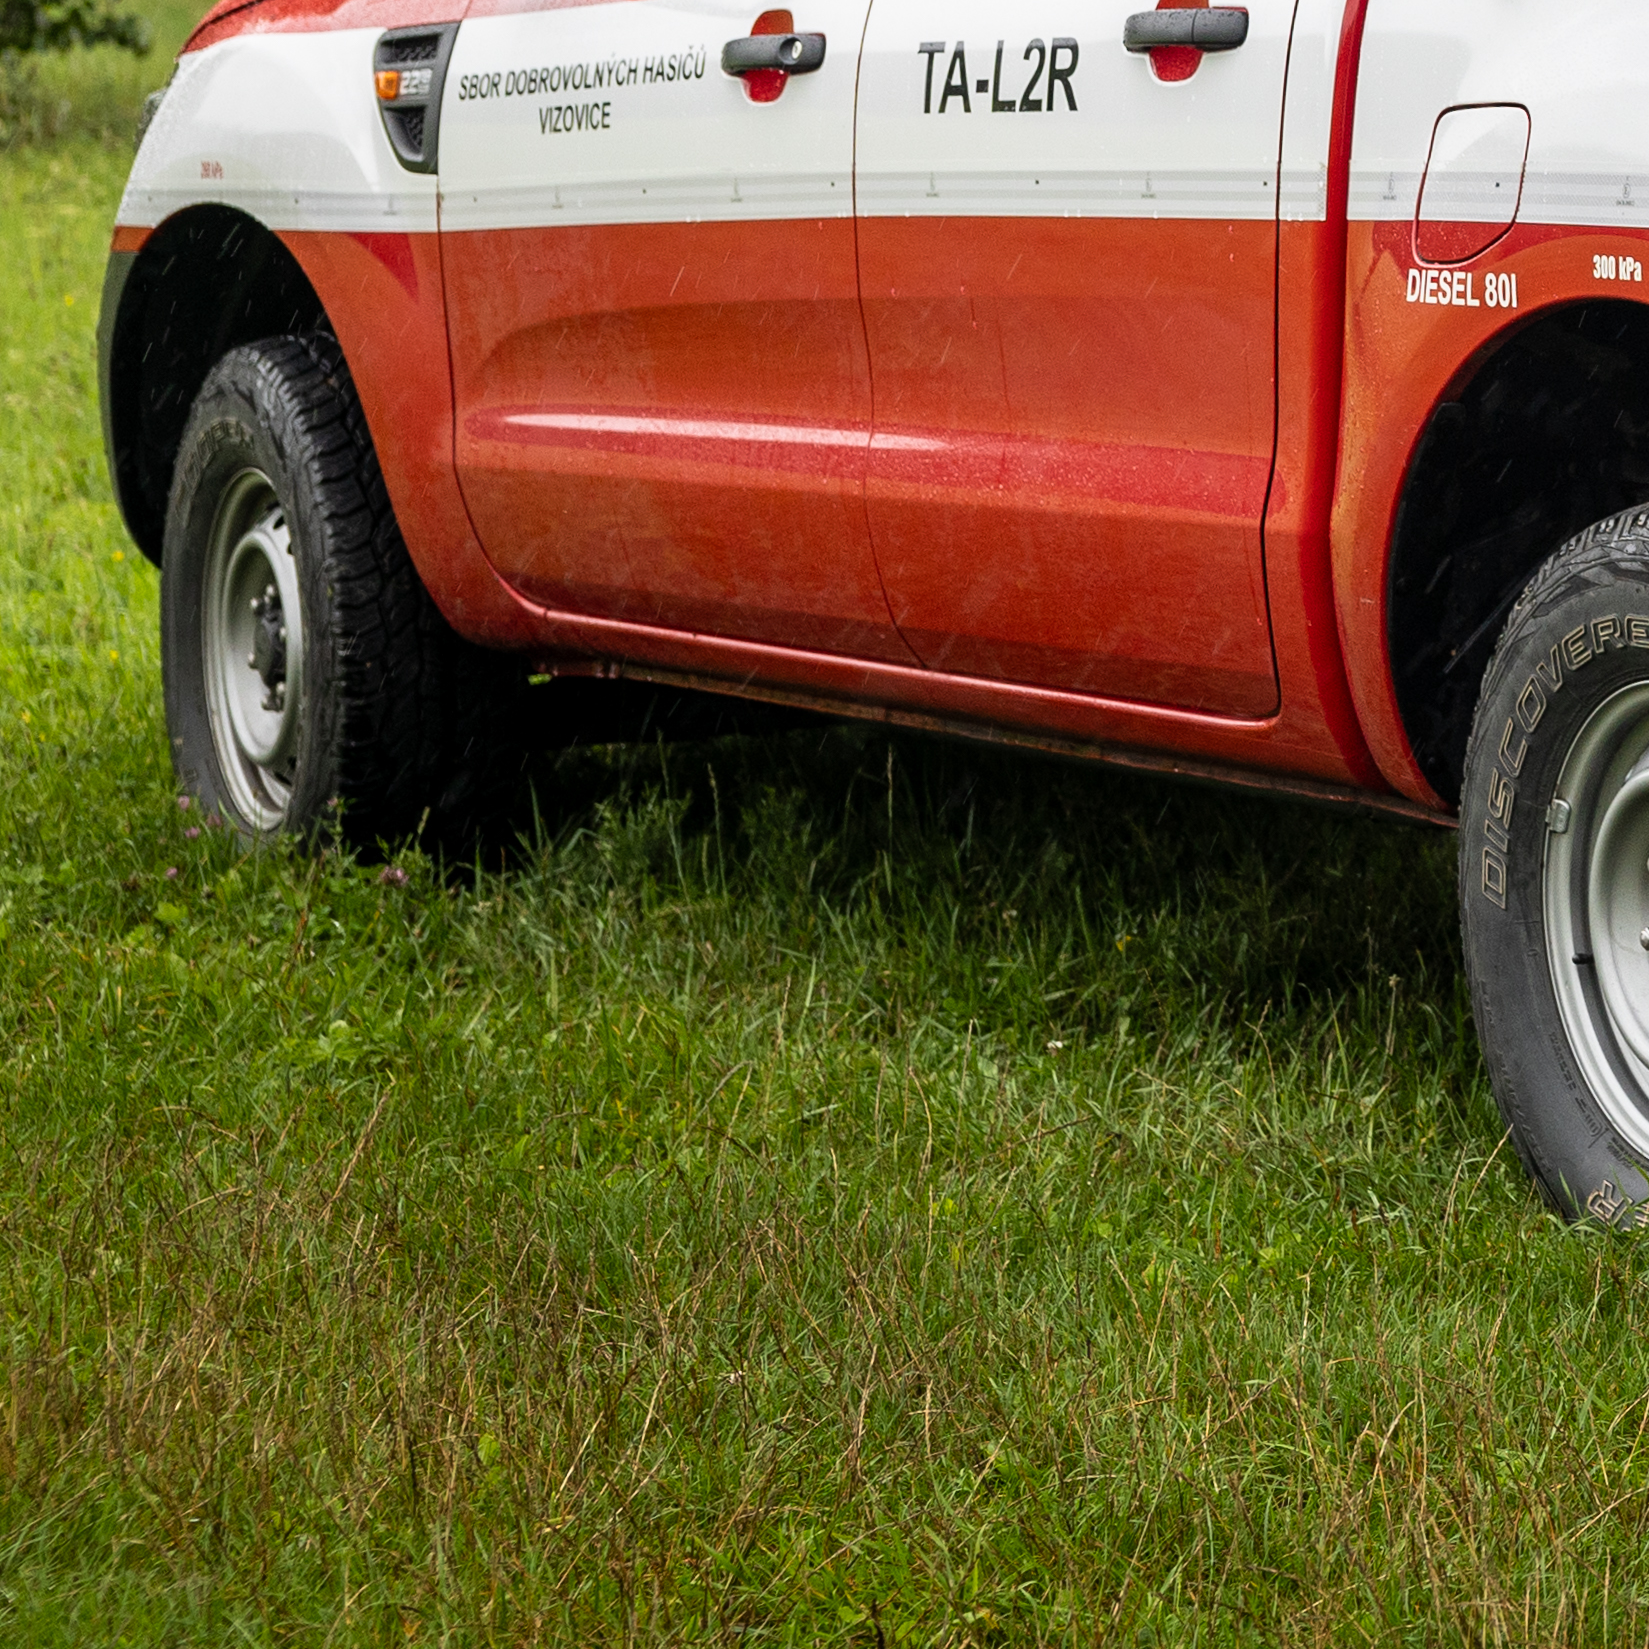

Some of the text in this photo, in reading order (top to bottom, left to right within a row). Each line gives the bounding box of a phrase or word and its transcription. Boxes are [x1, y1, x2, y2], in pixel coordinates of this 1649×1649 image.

[458, 71, 502, 101] SBOR
[504, 51, 640, 97] DOBROVOLNÝCH
[642, 43, 707, 85] HASIČŮ
[917, 36, 1080, 114] TA-L2R
[539, 101, 611, 135] VIZOVICE
[1406, 268, 1480, 307] DIESEL
[1592, 254, 1642, 282] 300 kPa
